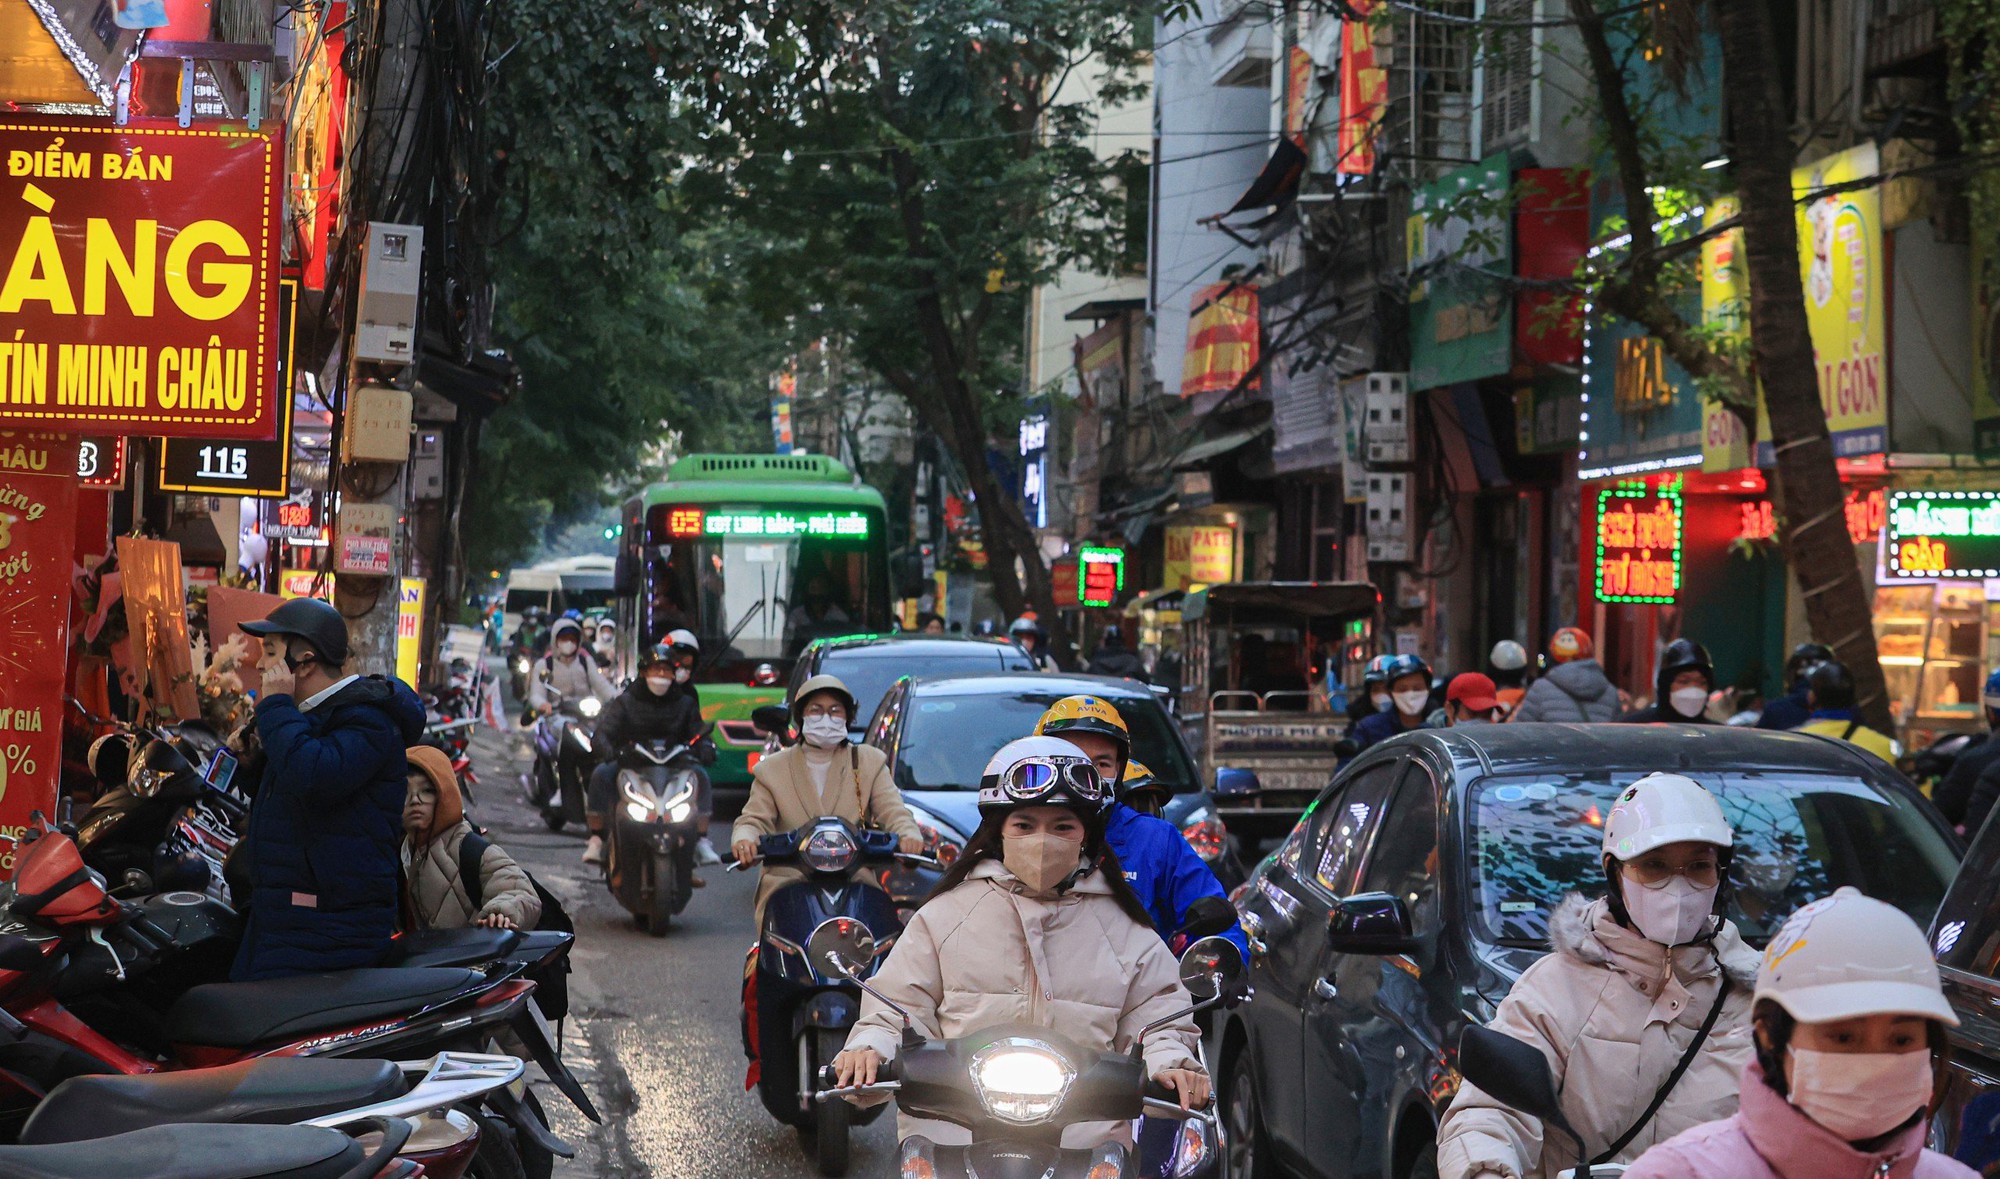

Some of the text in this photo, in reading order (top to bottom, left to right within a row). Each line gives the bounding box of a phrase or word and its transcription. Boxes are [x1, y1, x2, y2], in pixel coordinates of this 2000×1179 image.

[8, 136, 173, 181] ĐIỂM BÁN
[0, 329, 248, 411] TÍN MINH CHÂU
[199, 446, 247, 474] 115
[672, 510, 700, 533] 05
[14, 706, 42, 731] GIÁ
[1077, 706, 1107, 715] AVIVA
[993, 1152, 1031, 1160] HONDA
